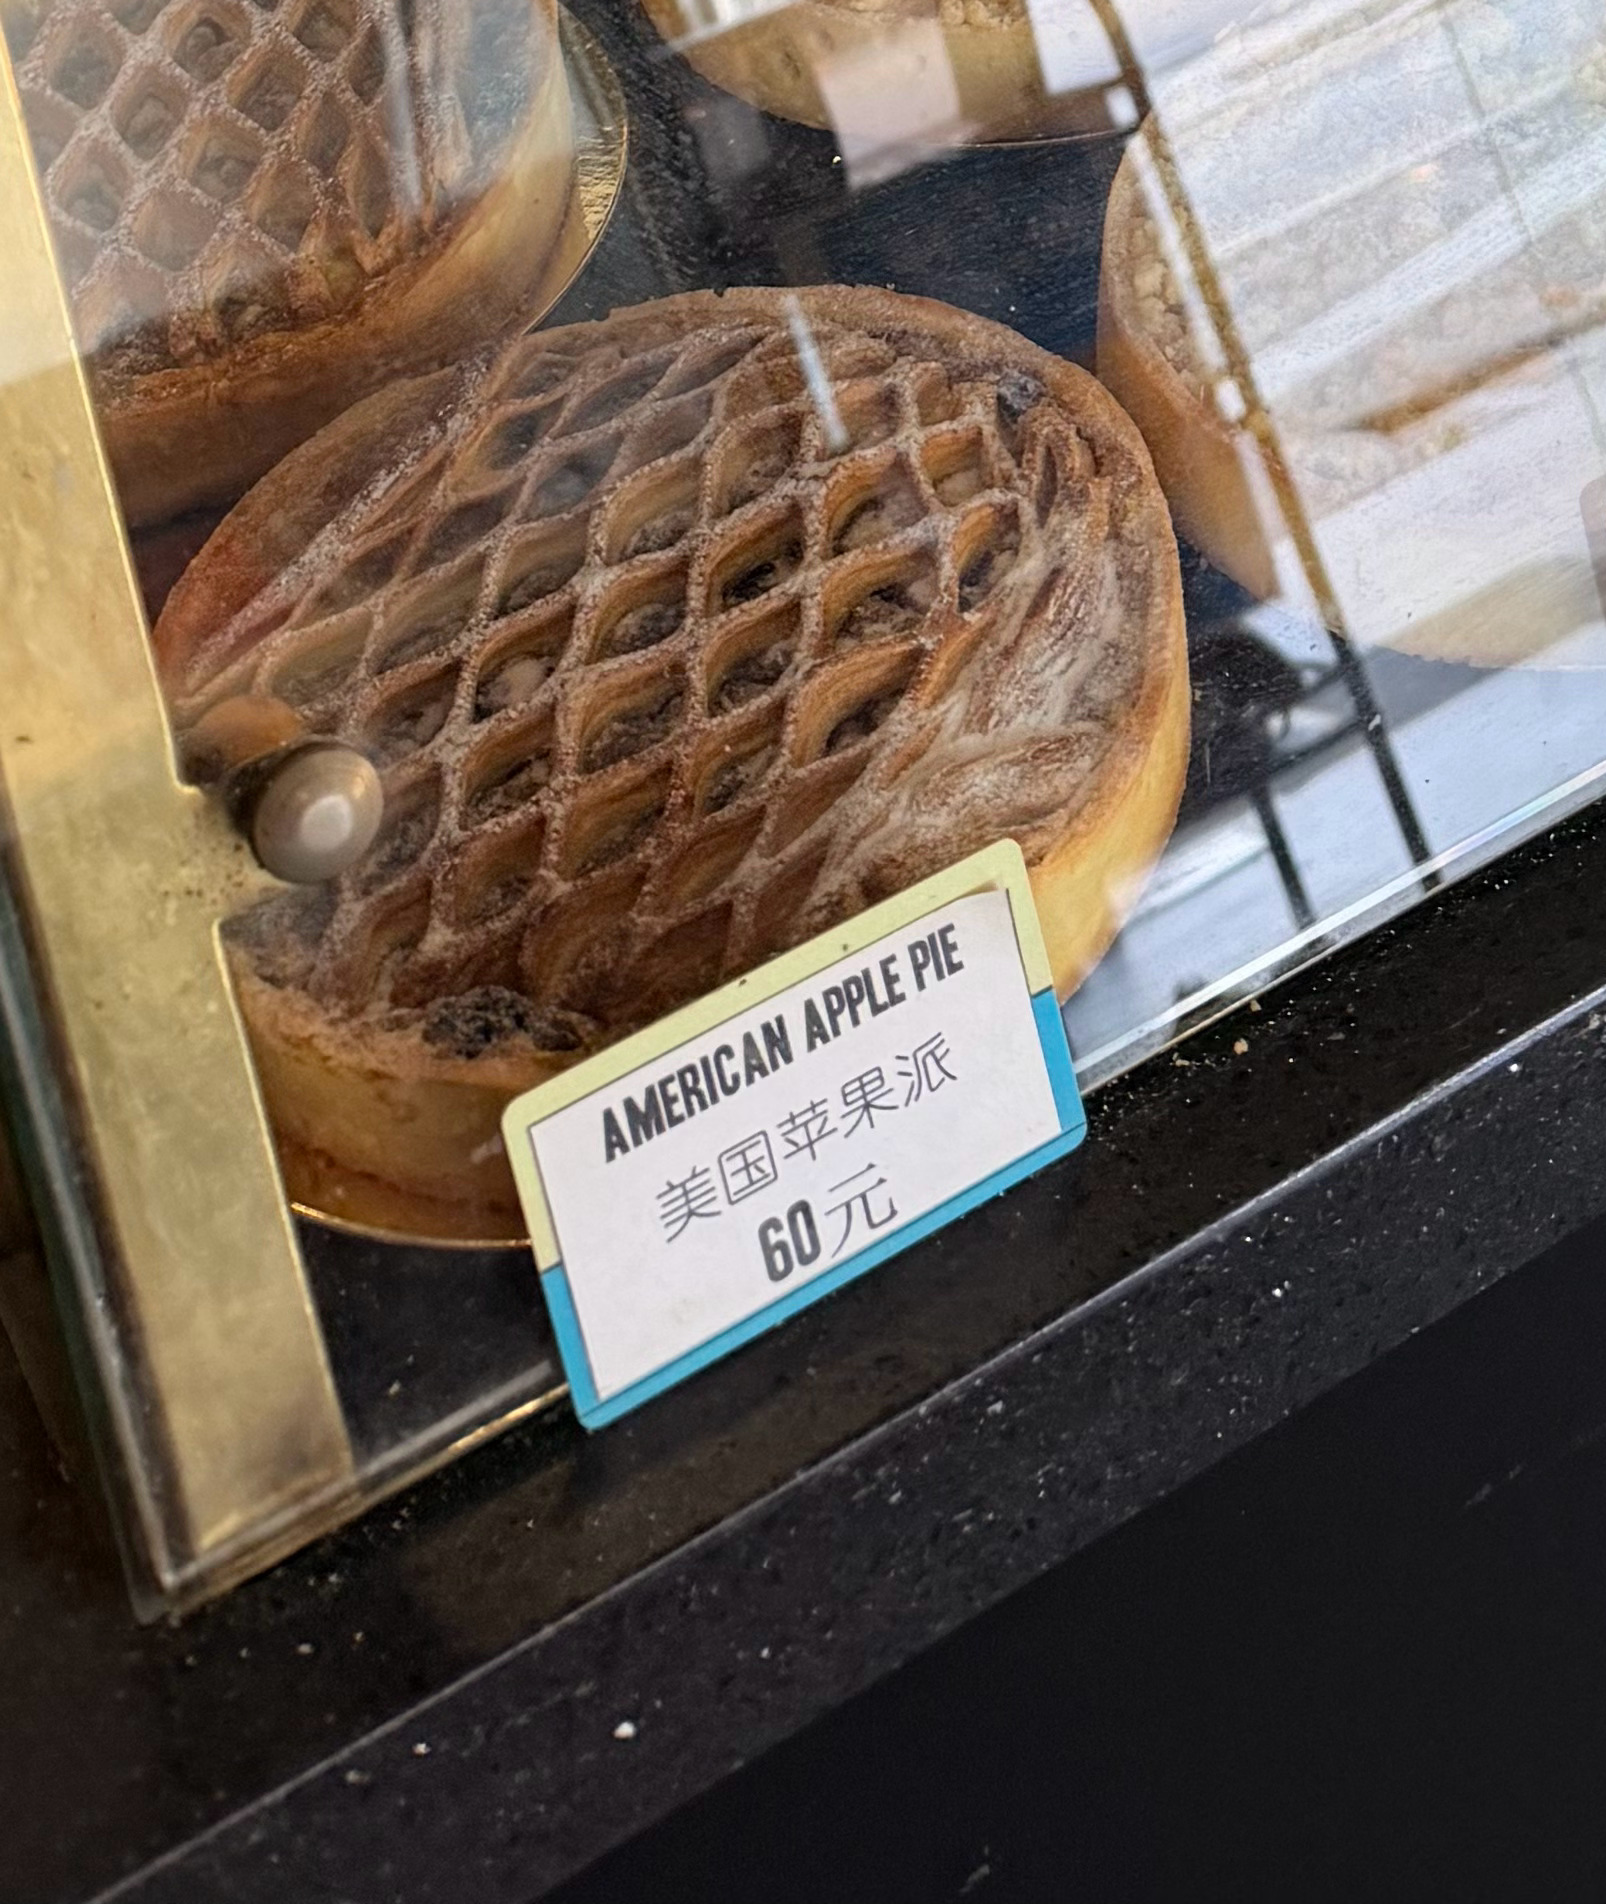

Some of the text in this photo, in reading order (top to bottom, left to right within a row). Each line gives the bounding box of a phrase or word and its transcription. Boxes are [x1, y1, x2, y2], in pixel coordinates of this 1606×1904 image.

[602, 923, 965, 1164] AMERICAN APPLE PIE
[655, 1032, 959, 1242] 美国苹果派
[758, 1162, 898, 1283] 60元
